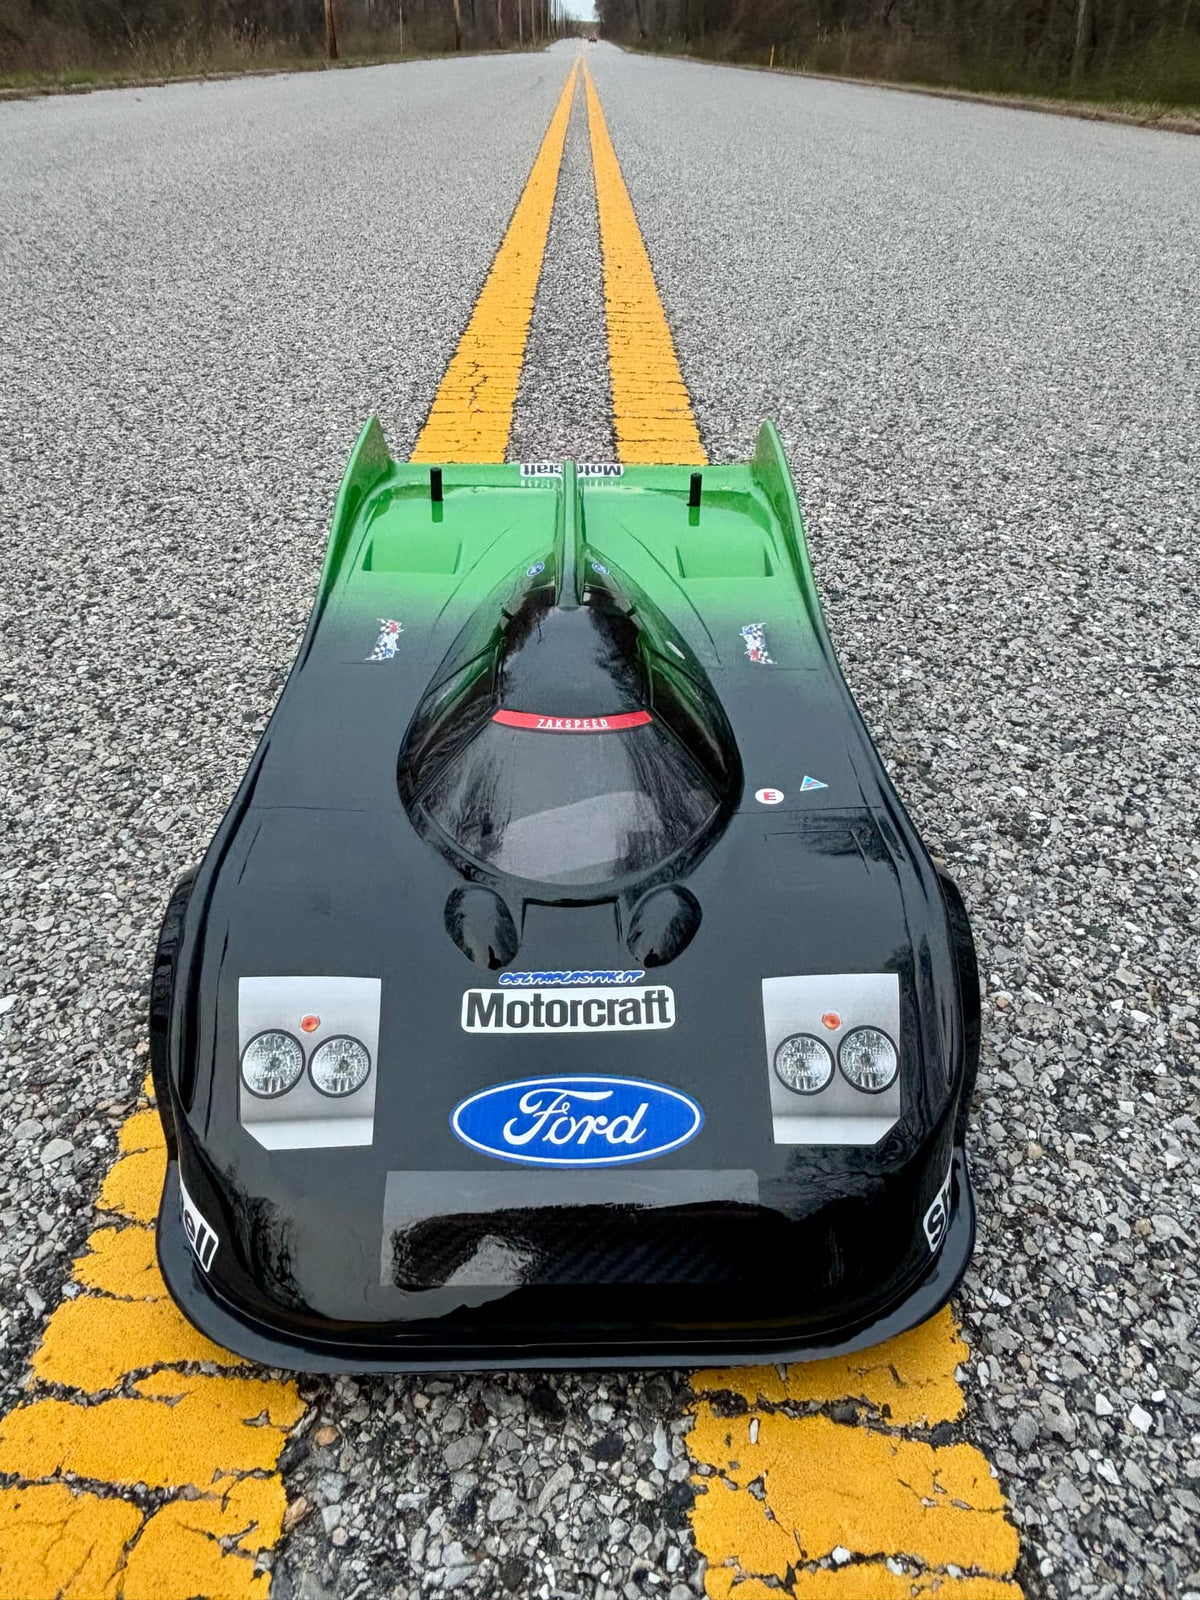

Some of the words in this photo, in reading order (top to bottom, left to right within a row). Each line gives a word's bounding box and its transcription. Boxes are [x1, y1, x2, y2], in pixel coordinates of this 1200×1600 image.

[537, 718, 608, 728] ZAKSPEED
[466, 989, 671, 1028] Motorcraft
[503, 1088, 649, 1146] Ford
